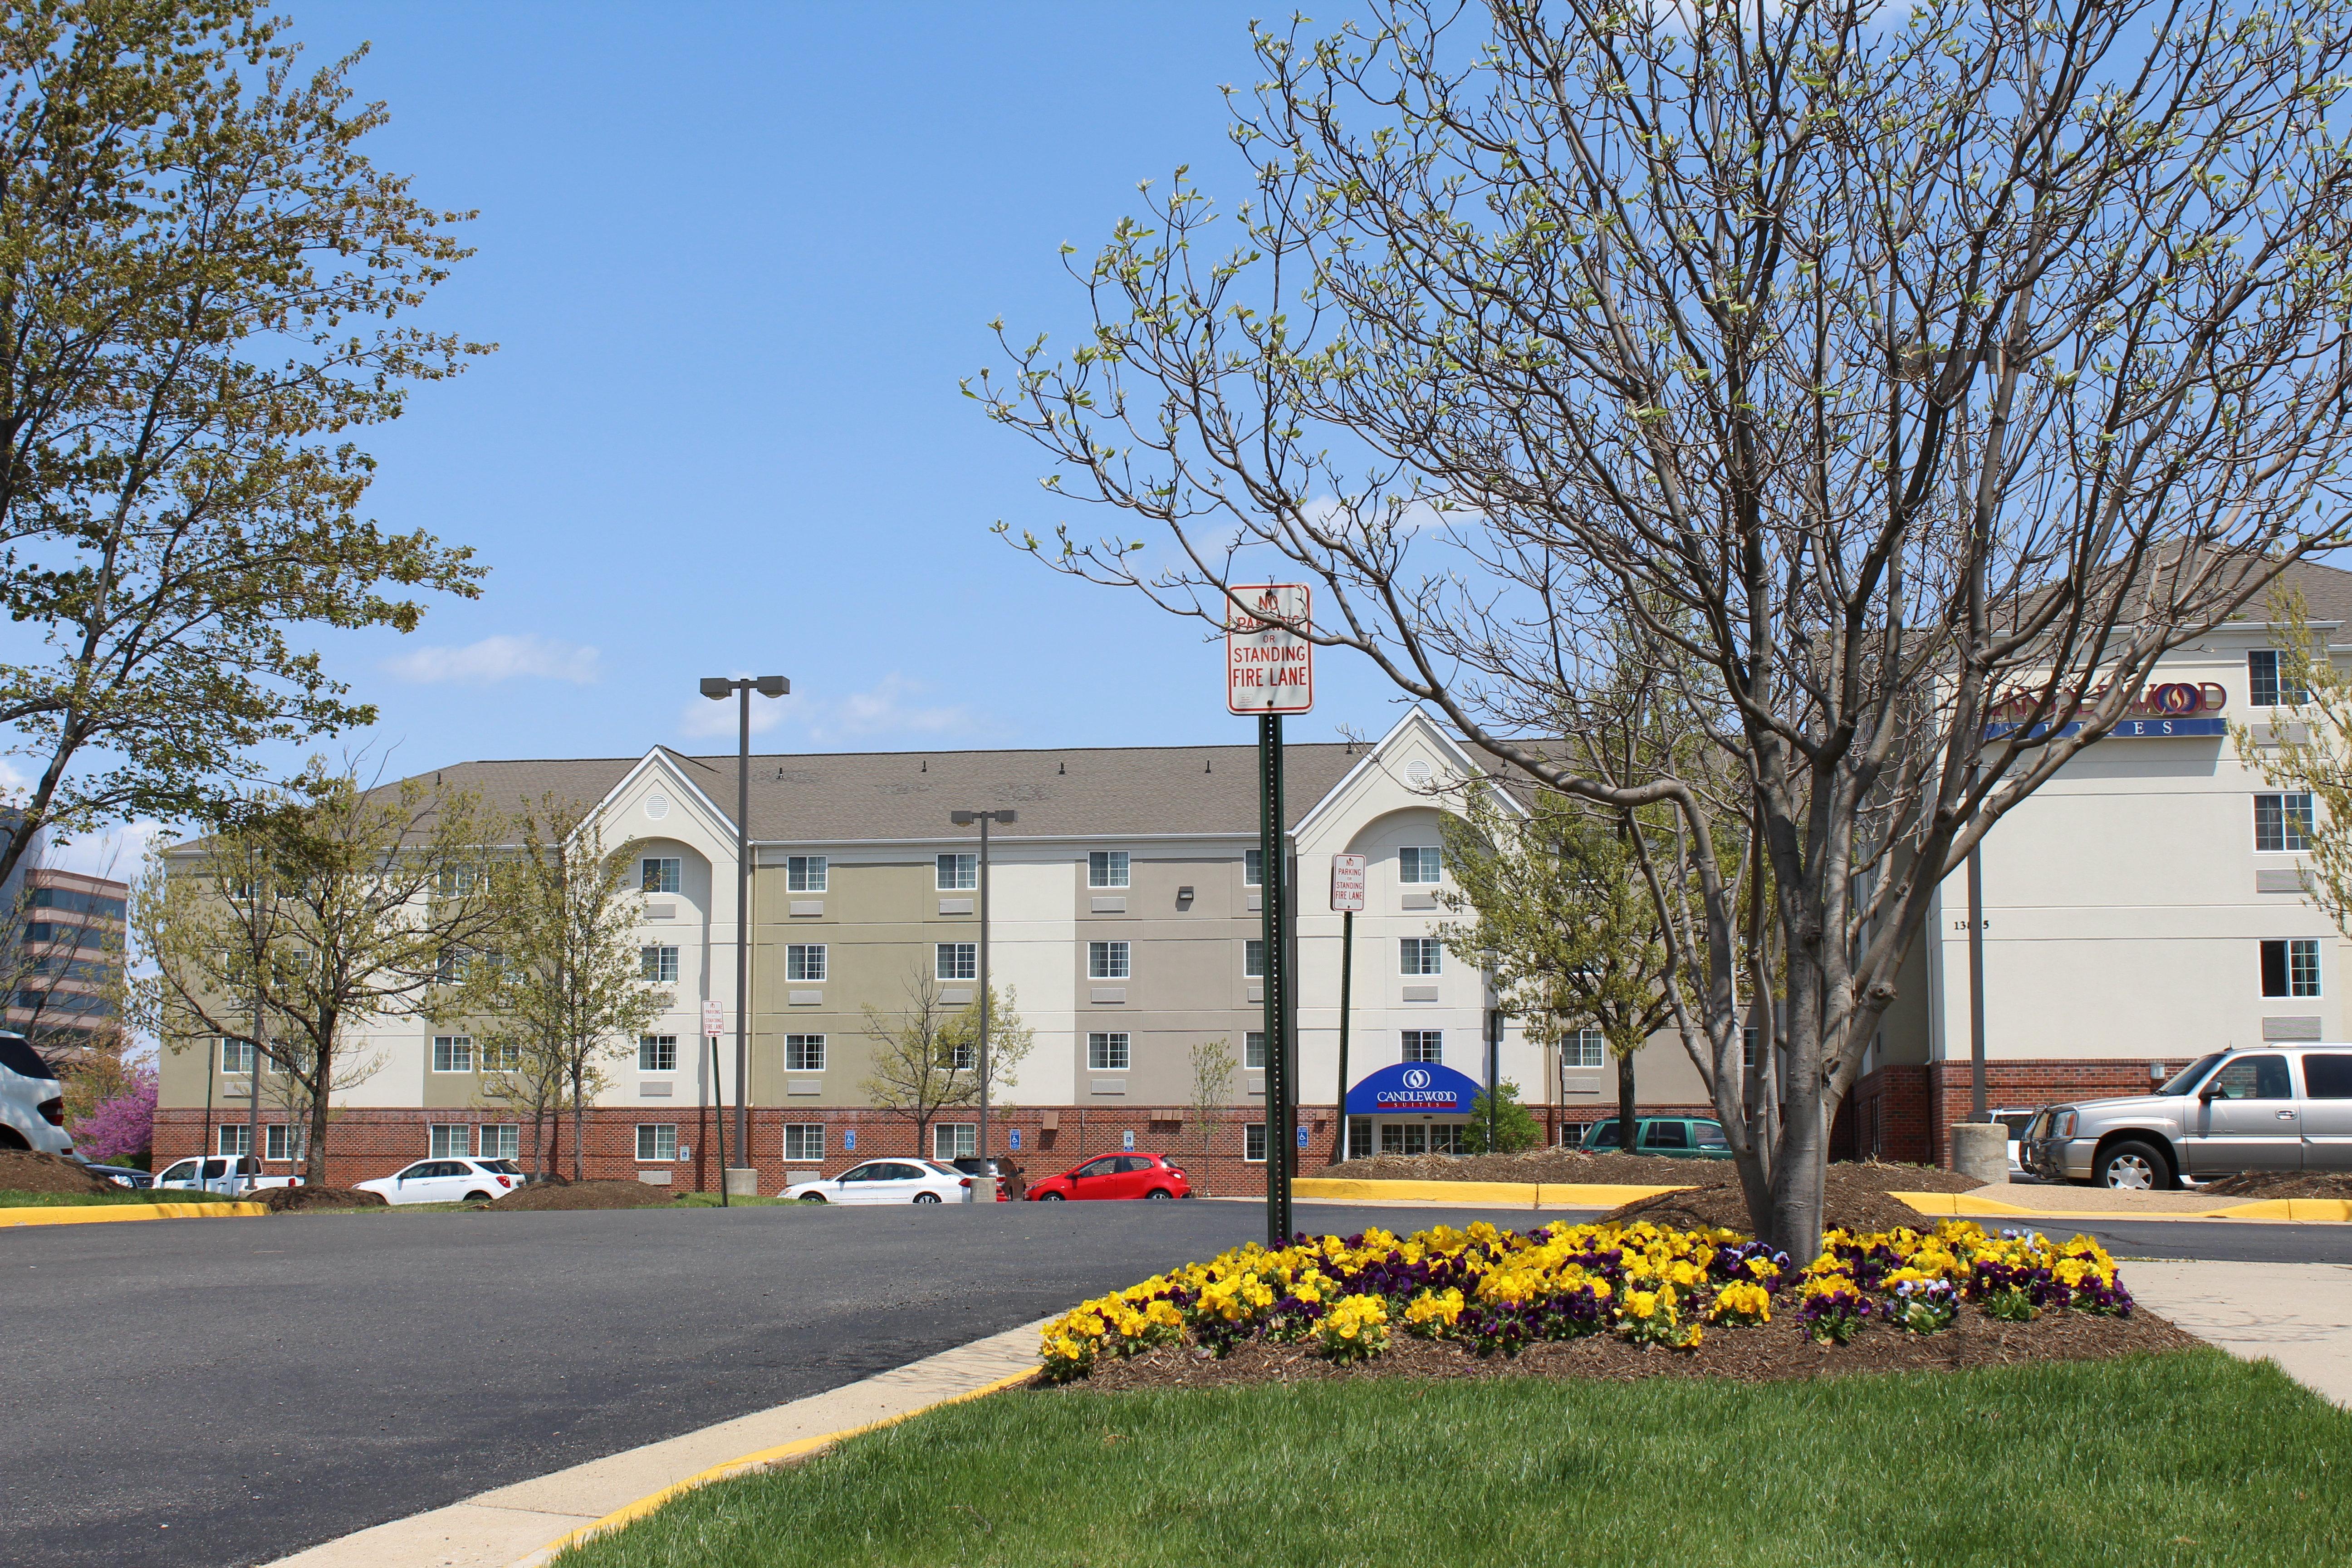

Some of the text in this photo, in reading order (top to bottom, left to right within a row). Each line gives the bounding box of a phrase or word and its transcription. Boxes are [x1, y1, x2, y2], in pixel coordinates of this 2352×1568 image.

[1259, 595, 1278, 610] NO
[1238, 615, 1300, 631] PANG
[1234, 646, 1305, 663] STANDING
[1233, 666, 1307, 687] FIRE LANE
[1969, 682, 2226, 716] ANDLWOOD
[1338, 868, 1361, 876] PARKING
[1336, 882, 1362, 890] STANDING
[1336, 891, 1362, 900] FIRE LANE
[1954, 920, 1989, 930] 135
[1377, 1091, 1457, 1102] CANDLEWOOD
